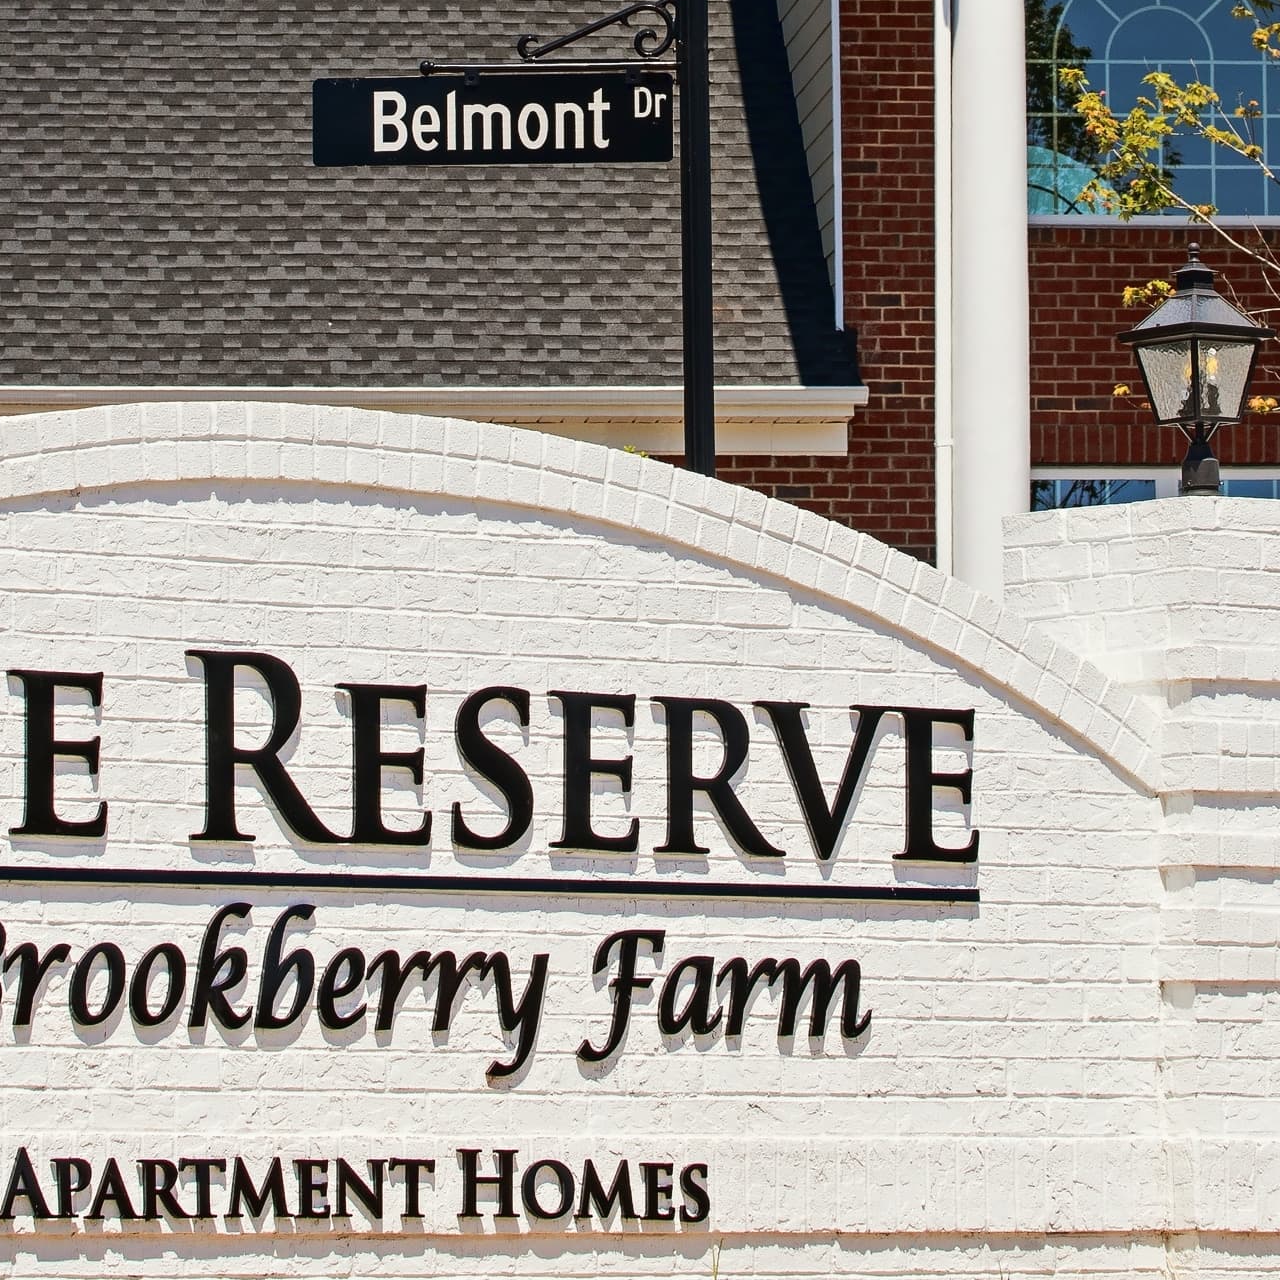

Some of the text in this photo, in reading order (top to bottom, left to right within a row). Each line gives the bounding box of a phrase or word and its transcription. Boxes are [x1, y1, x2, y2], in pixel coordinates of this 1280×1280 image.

[374, 87, 666, 152] Belmont Dr
[185, 650, 979, 863] RESERVE
[577, 930, 872, 1061] Farm
[456, 1149, 709, 1222] HOMES
